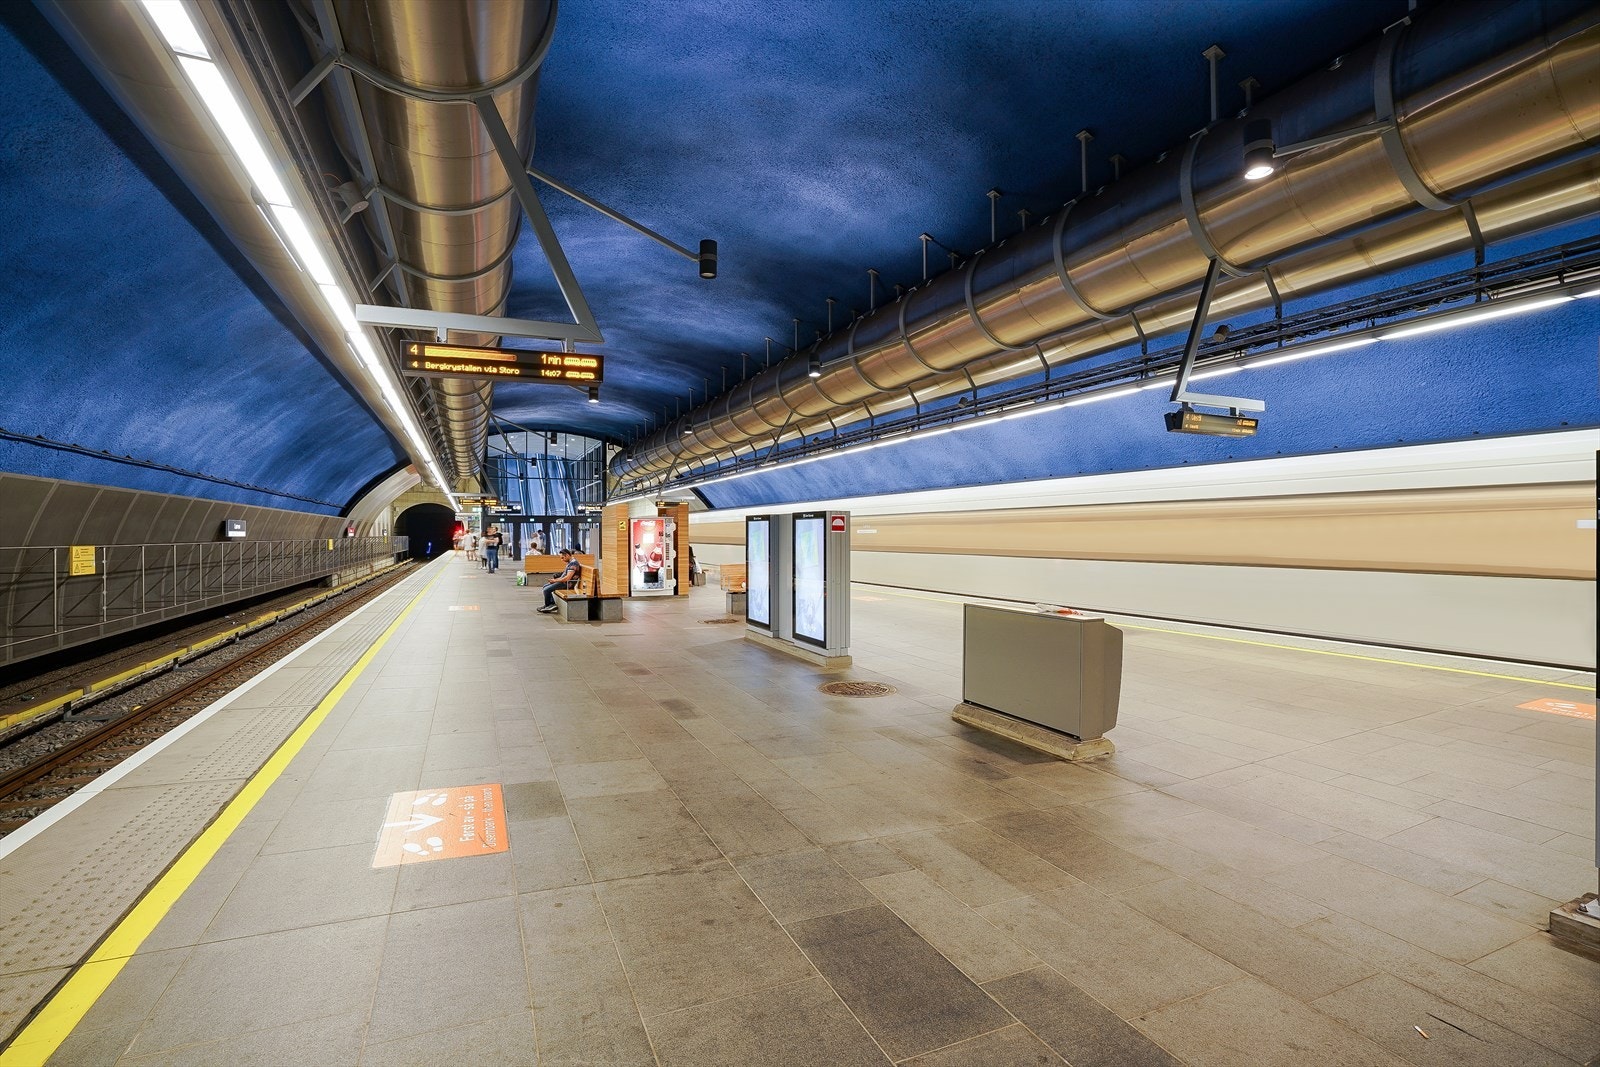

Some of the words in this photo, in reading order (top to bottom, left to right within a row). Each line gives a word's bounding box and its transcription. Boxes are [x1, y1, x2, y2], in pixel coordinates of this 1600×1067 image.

[410, 344, 418, 355] 4
[541, 354, 547, 365] 1
[547, 355, 562, 365] min
[425, 361, 482, 372] Bergkrystallen
[484, 365, 497, 373] via
[541, 369, 561, 377] 14:07
